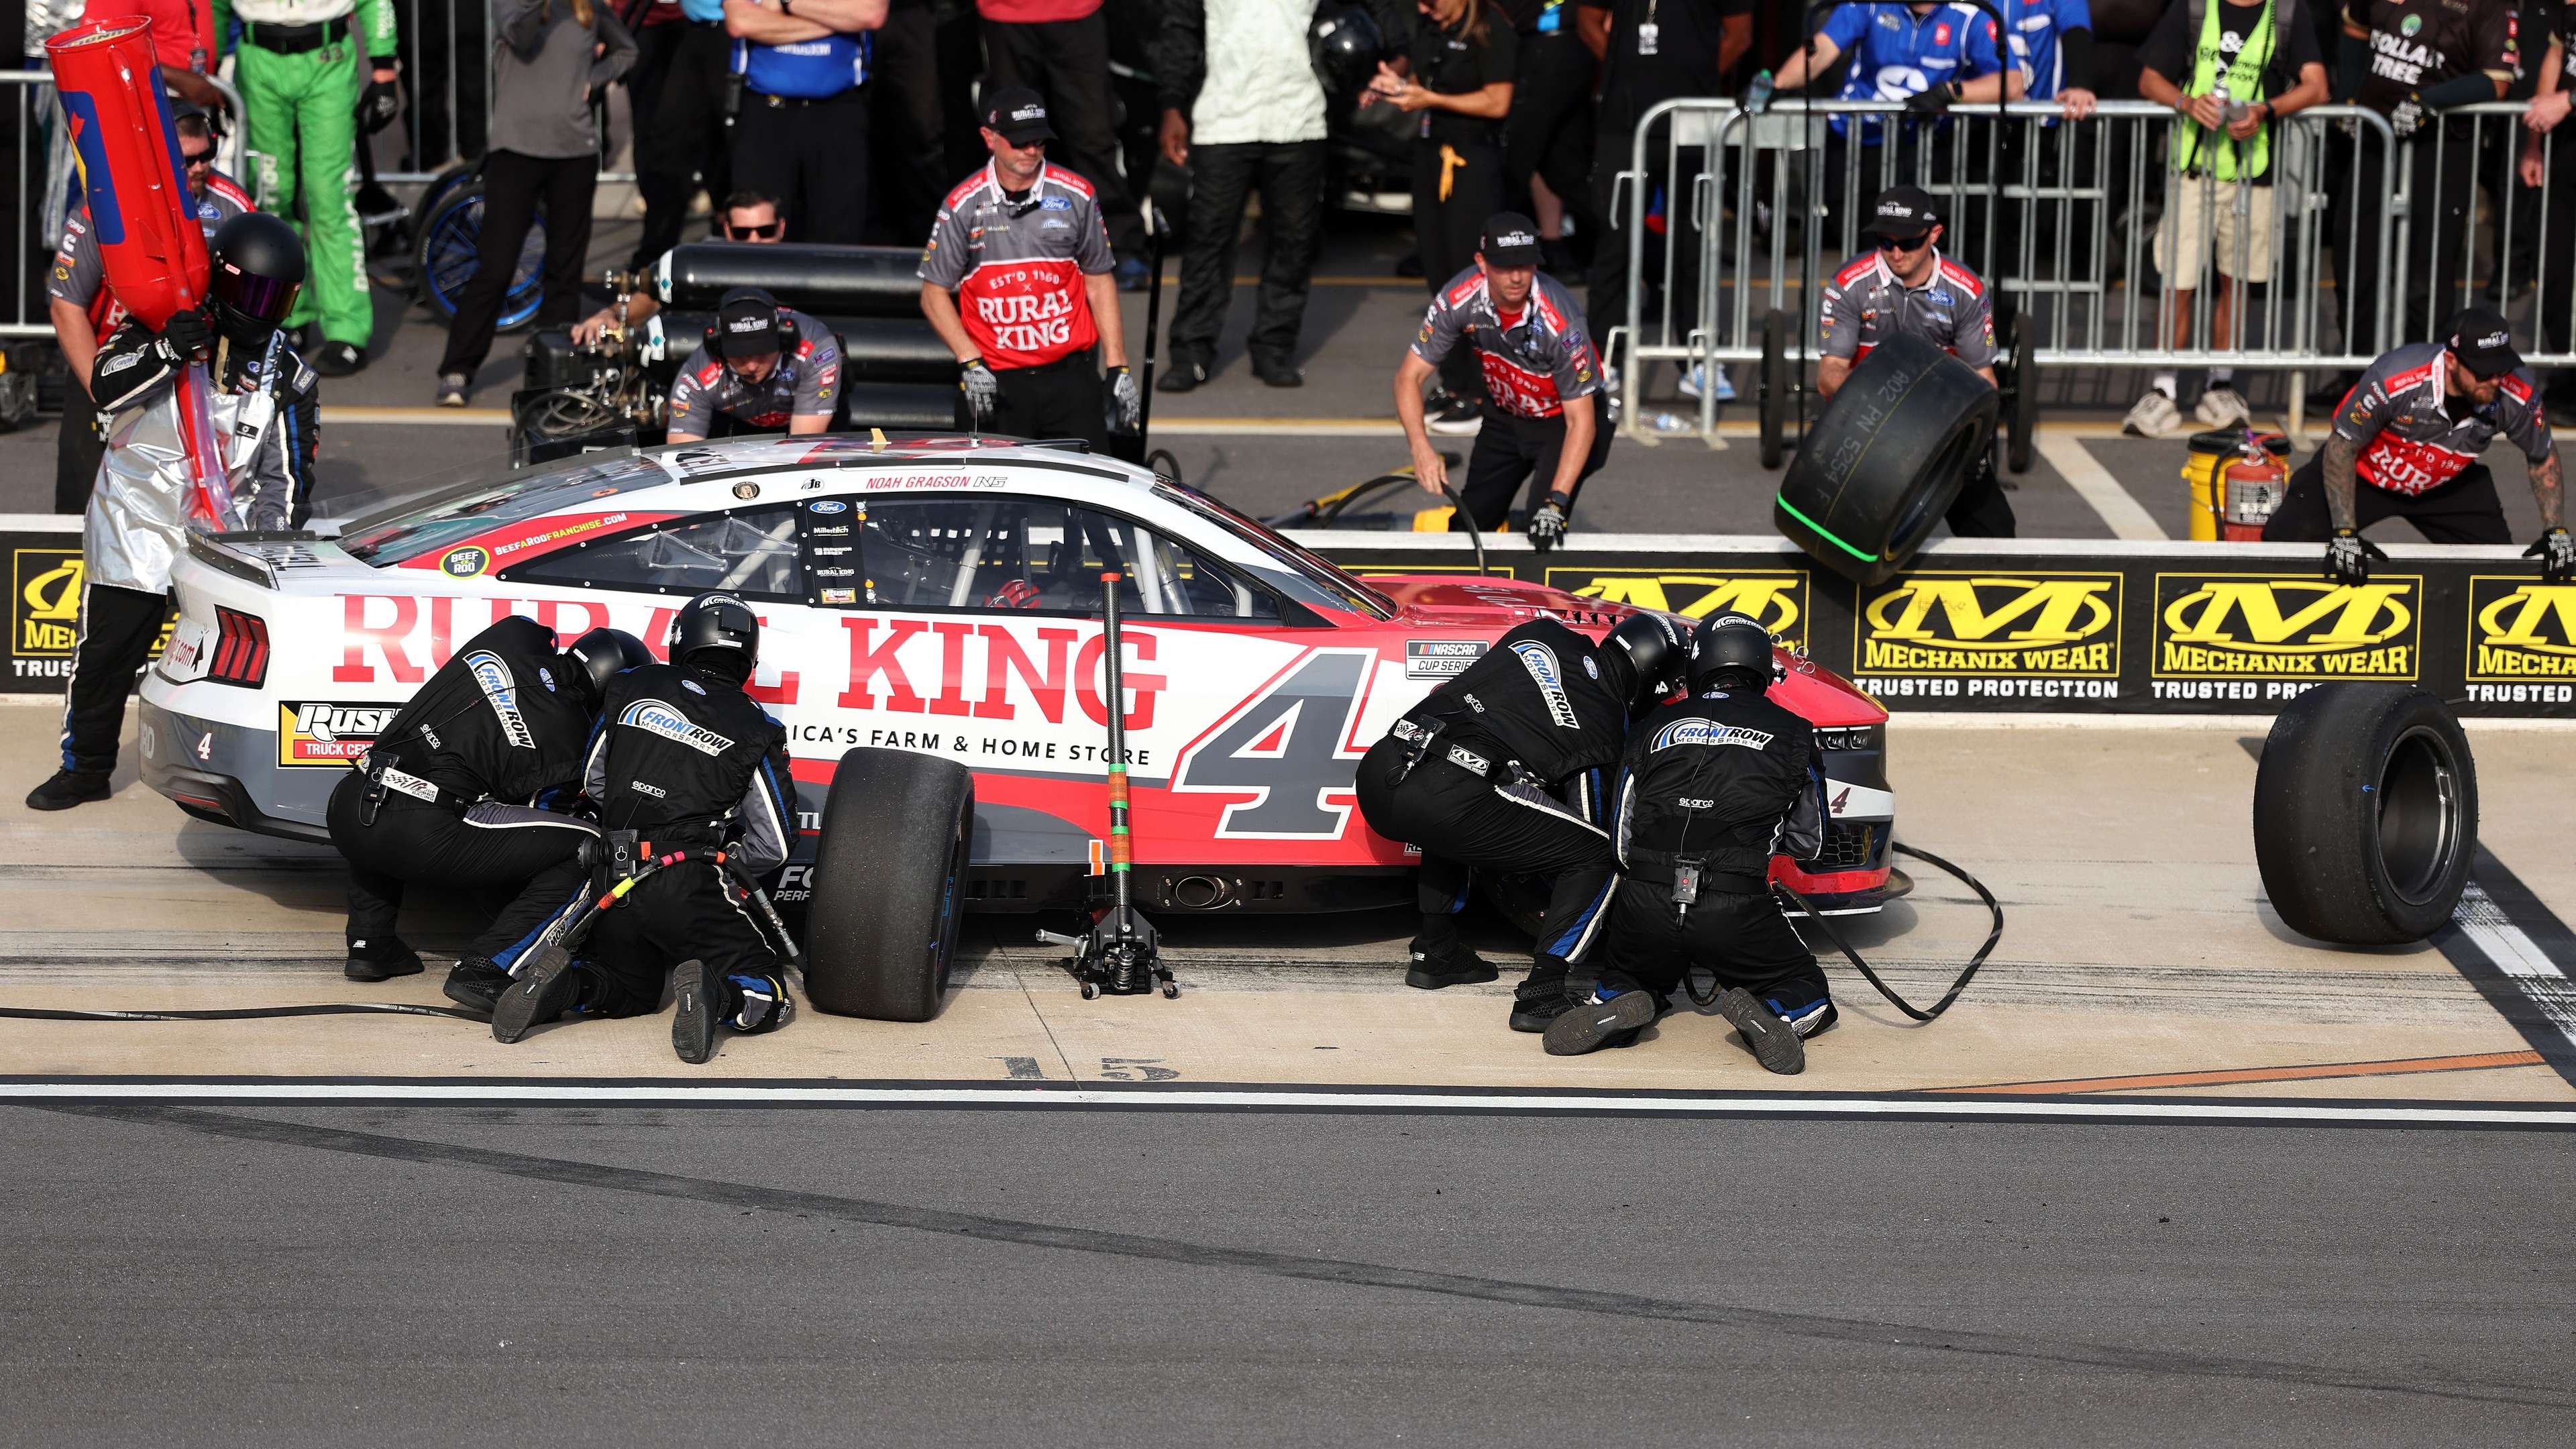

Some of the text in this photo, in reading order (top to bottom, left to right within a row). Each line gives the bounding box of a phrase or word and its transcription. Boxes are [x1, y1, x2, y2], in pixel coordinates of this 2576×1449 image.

[2371, 53, 2422, 85] TREE
[977, 288, 1073, 351] RURAL KING
[865, 478, 902, 489] NOAH
[906, 476, 971, 488] GRAGSON
[451, 550, 480, 563] BEEF
[453, 562, 476, 574] ROO
[1432, 644, 1477, 655] NASCAR
[1864, 638, 2109, 671] MECHANIX WEAR
[2162, 642, 2408, 674] MECHANIX WEAR
[11, 660, 74, 677] TRUS
[1418, 660, 1471, 671] CUP SERIE
[2477, 644, 2576, 675] MECHA
[837, 616, 1167, 731] KING
[1654, 681, 1669, 694] 4
[1853, 679, 2118, 698] TRUSTED PROTECTION
[2151, 682, 2258, 699] TRUSTED
[2466, 684, 2573, 702] TRUSTED
[197, 731, 213, 761] 4
[641, 720, 718, 755] MOTORSPORTS
[793, 724, 858, 744] ICA'S
[871, 730, 940, 750] FARM
[953, 735, 969, 753] &
[983, 739, 1057, 760] HOME
[1171, 646, 1379, 841] 4
[1676, 737, 1762, 749] MOTORSPORTS
[305, 743, 341, 755] TRUCK
[1470, 766, 1485, 775] WEAR
[411, 790, 435, 802] RACING
[631, 780, 666, 798] sparco
[1678, 796, 1714, 808] sparco
[1830, 787, 1851, 814] 4
